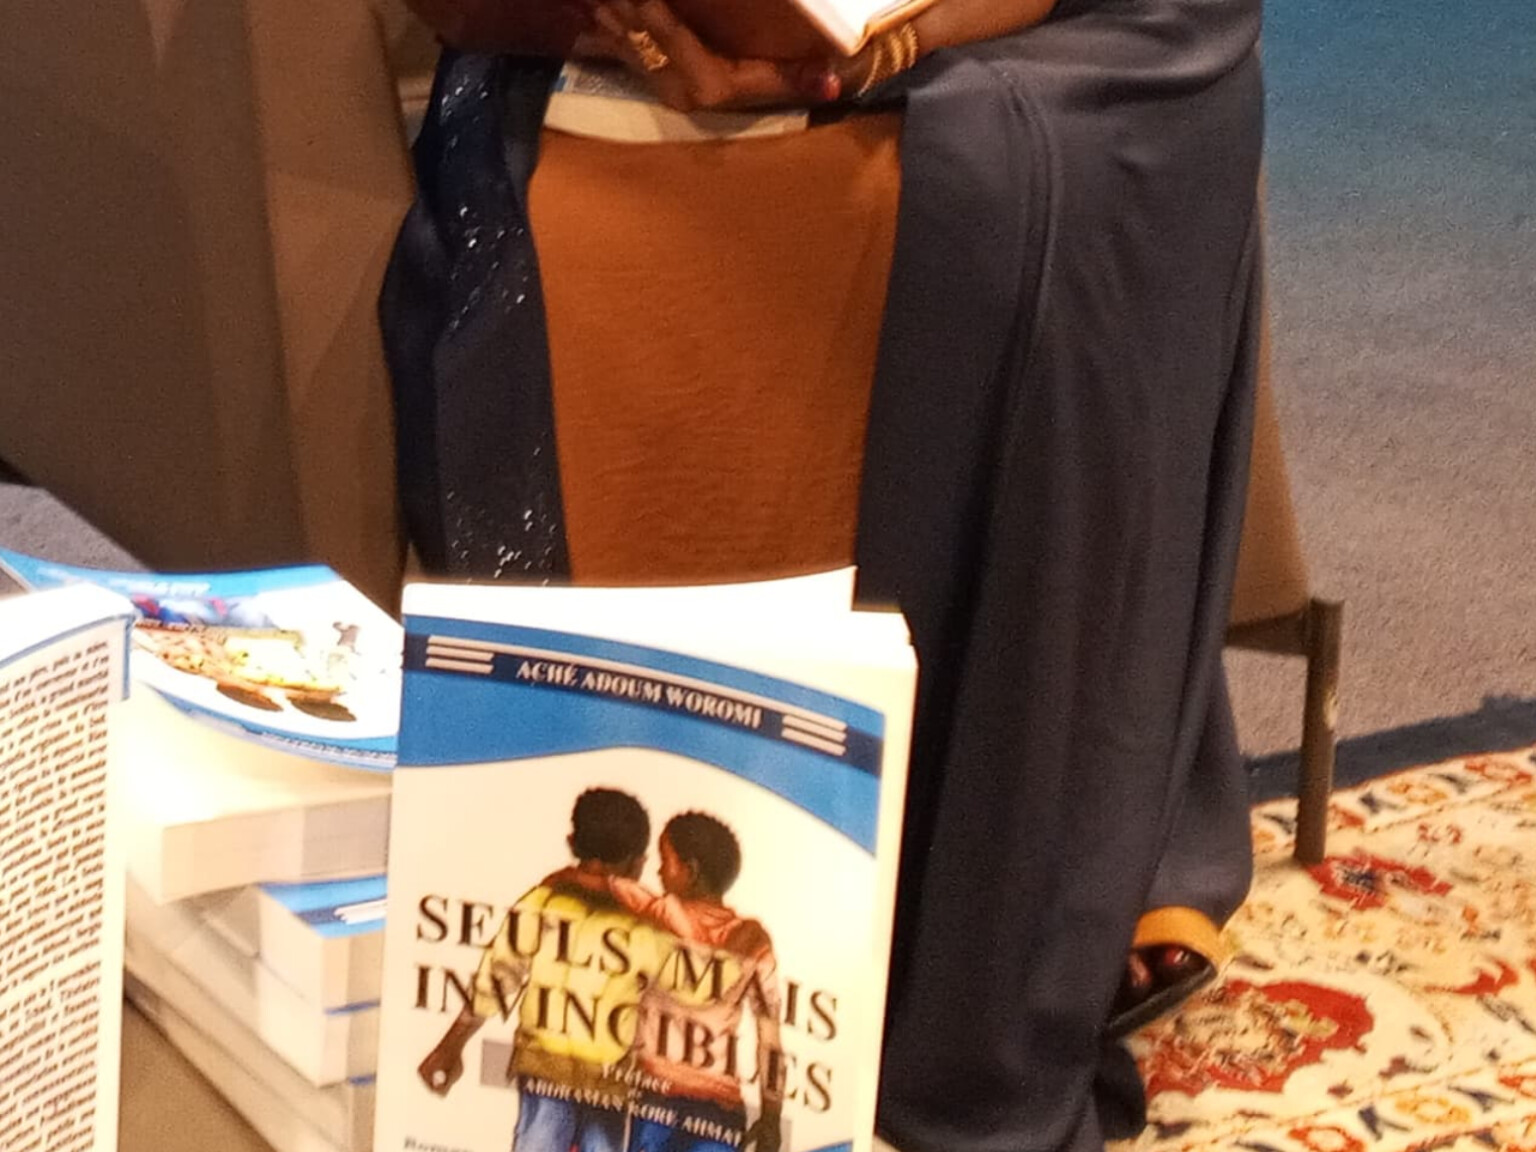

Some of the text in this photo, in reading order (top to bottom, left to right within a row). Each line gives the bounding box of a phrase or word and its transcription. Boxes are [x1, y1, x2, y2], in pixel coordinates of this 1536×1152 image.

[516, 659, 763, 730] ACHÉ ADOUM WOROMI
[412, 965, 834, 1114] INVINCIBLES
[416, 893, 838, 1041] SEULS, MAIS
